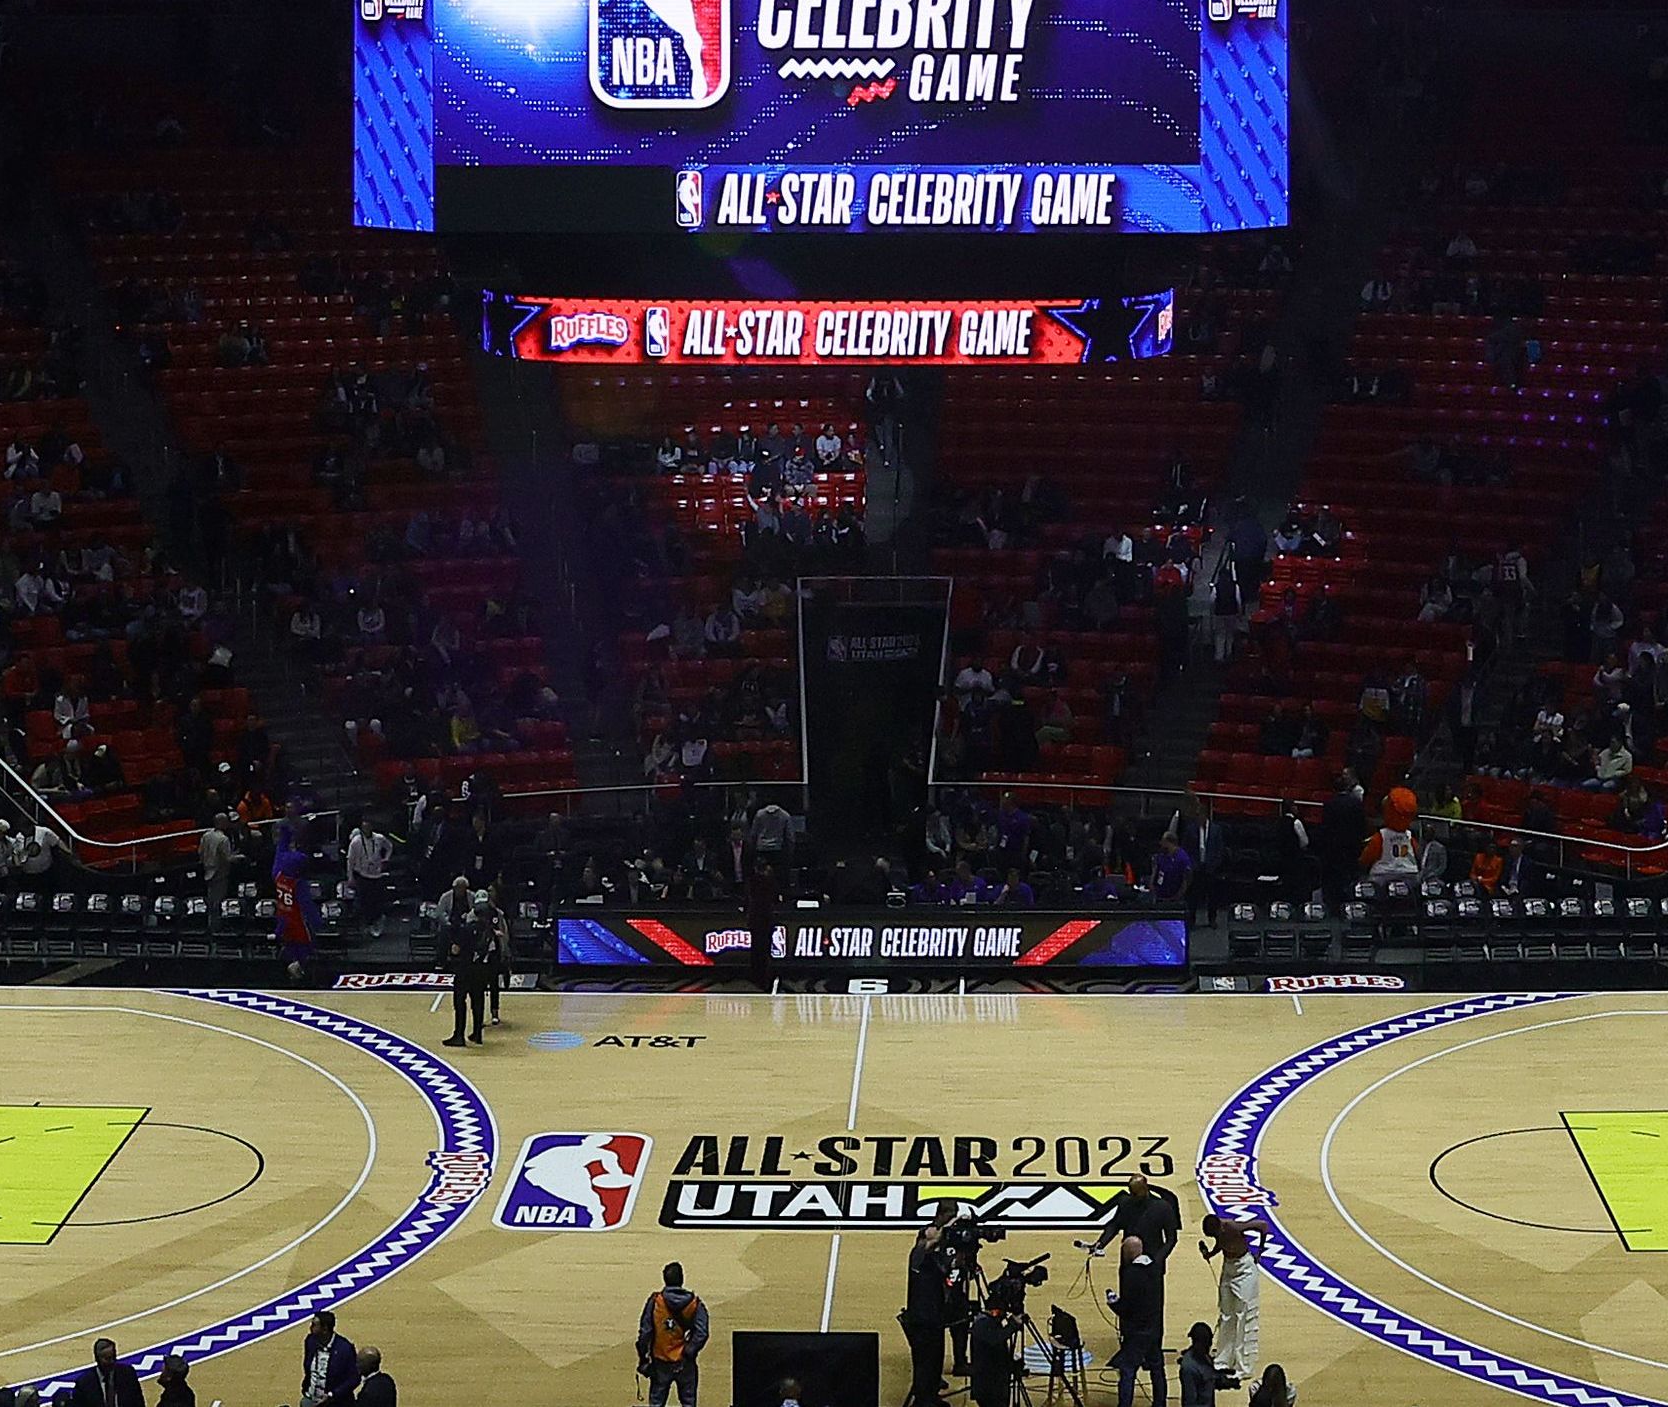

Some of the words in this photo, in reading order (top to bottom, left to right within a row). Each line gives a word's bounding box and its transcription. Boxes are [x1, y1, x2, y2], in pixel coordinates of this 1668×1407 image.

[611, 37, 677, 86] NBA
[908, 54, 1023, 102] GAME
[868, 174, 1022, 225] CELEBRITY
[1032, 174, 1115, 225] GAME
[552, 314, 627, 344] RUFFLES
[814, 310, 951, 355] CELEBRITY
[958, 310, 1032, 355] GAME
[706, 929, 751, 953] RUFFLE
[881, 928, 969, 957] CELEBRITY
[973, 928, 1021, 957] GAME
[336, 973, 454, 988] RUFFLE
[848, 978, 889, 993] 6
[1270, 975, 1404, 990] RUFFLES
[593, 1035, 707, 1049] AT&T
[1011, 1136, 1174, 1178] 2023
[428, 1153, 487, 1203] RUFFLES
[1202, 1155, 1266, 1204] RUFFLES
[512, 1205, 577, 1225] NBA
[676, 1184, 904, 1217] UTAH
